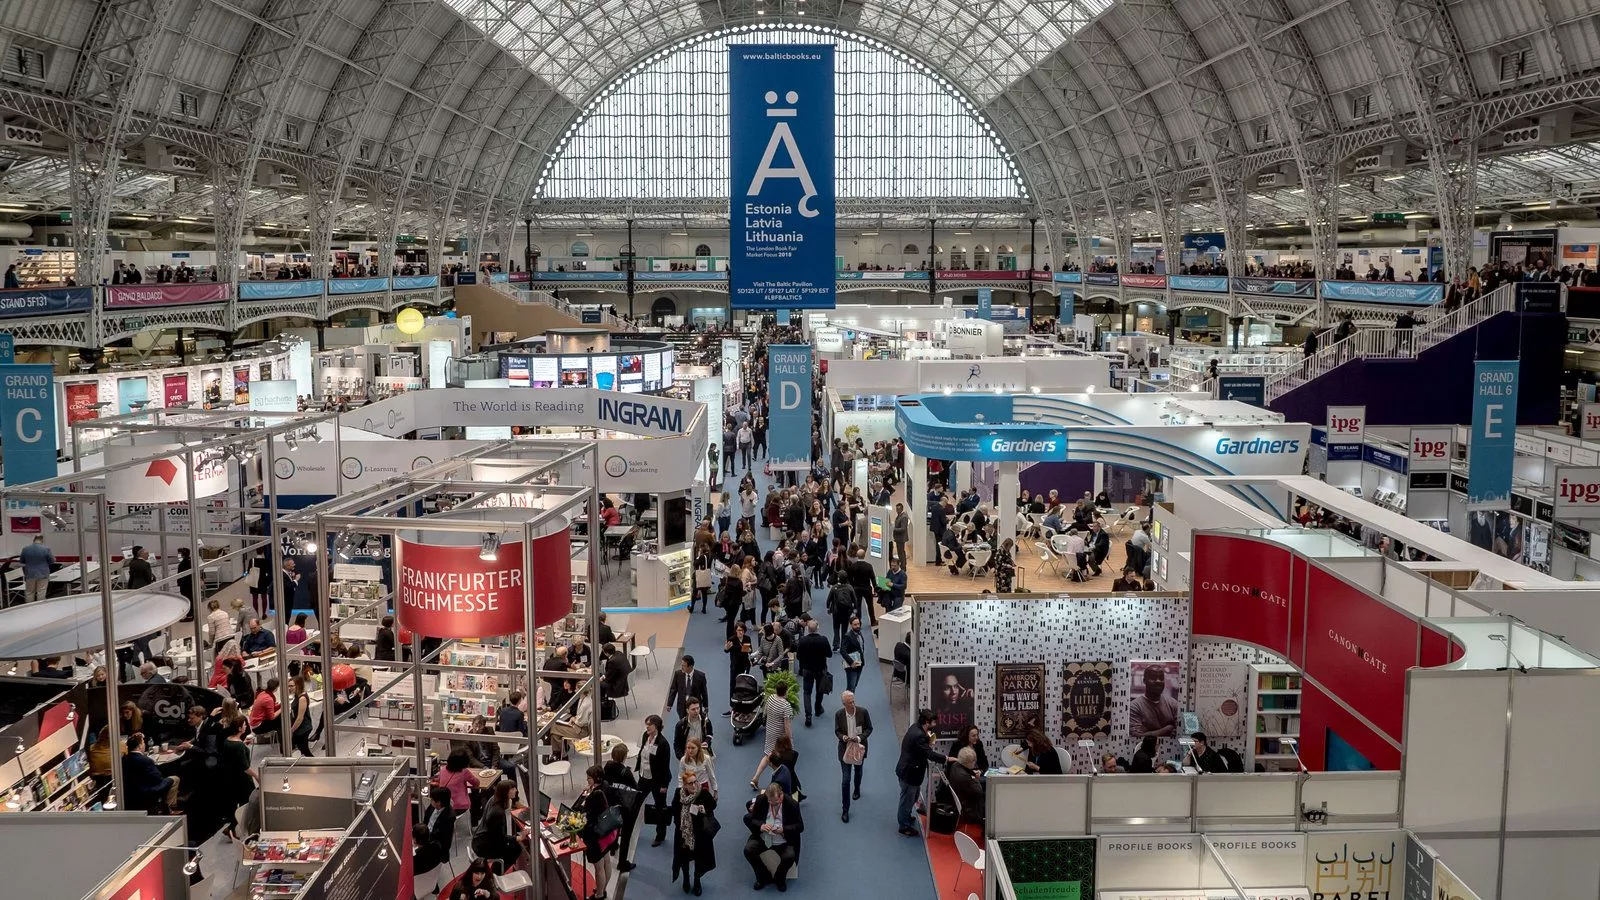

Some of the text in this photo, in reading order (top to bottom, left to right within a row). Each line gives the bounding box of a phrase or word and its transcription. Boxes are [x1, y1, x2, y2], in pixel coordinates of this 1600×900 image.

[745, 203, 792, 214] Estonia
[745, 217, 783, 228] Latvia
[745, 231, 804, 242] Lithuania
[1397, 289, 1417, 298] CENTRE
[0, 295, 47, 309] STAND 5F131
[981, 299, 988, 309] E
[1065, 300, 1070, 308] F
[953, 327, 983, 337] BONNIER
[774, 354, 807, 364] GRAND
[775, 365, 806, 374] HALL 6
[5, 375, 48, 387] GRAND
[1479, 372, 1514, 383] GRAND
[7, 388, 47, 399] HALL 6
[780, 381, 802, 410] D
[1479, 385, 1512, 396] HALL 6
[453, 401, 584, 414] The World is Reading
[598, 398, 682, 433] INGRAM
[1484, 404, 1503, 438] E
[1586, 412, 1600, 428] ip
[15, 408, 43, 443] C
[1331, 414, 1361, 432] ipg
[991, 437, 1056, 453] Gardners
[1216, 437, 1299, 455] Gardners
[1413, 437, 1448, 458] ipg
[364, 465, 398, 473] E-Learning
[628, 466, 658, 474] Marketing
[1560, 478, 1600, 503] ipg
[402, 565, 522, 592] FRANKFURTER
[403, 589, 499, 613] BUCHMESSE
[1003, 680, 1038, 690] PARRY
[1002, 692, 1039, 701] THE WAY OF
[1075, 695, 1099, 704] LITTLE
[154, 699, 186, 719] Go!
[1002, 701, 1039, 711] ALL FLESH
[937, 709, 967, 725] RISE
[1108, 842, 1193, 851] PROFILE BOOKS
[1213, 841, 1297, 850] PROFILE BOOKS
[1014, 885, 1079, 894] Schadenfreude:
